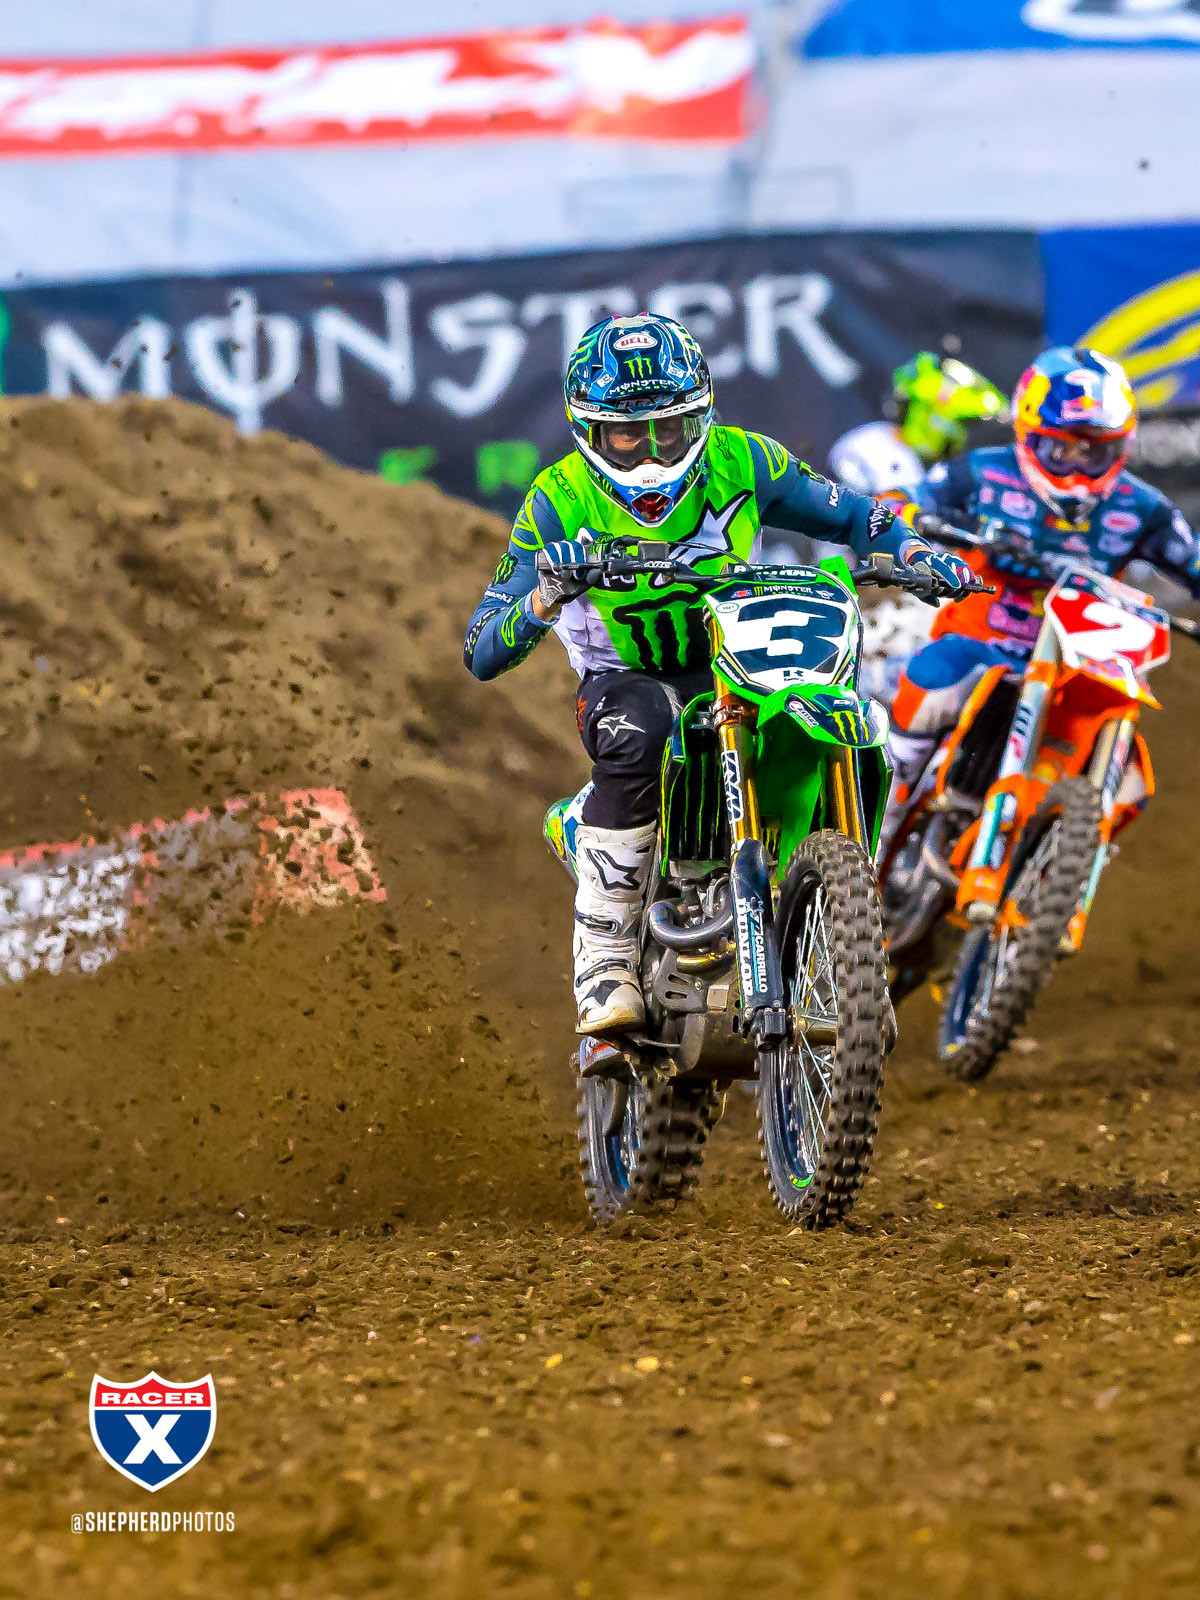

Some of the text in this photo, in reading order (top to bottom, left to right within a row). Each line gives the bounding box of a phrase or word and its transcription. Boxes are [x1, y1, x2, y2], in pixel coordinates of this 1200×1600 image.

[620, 336, 651, 347] BELL
[609, 379, 678, 395] MONSTER
[736, 597, 848, 675] 3
[754, 934, 769, 994] CARRILLO
